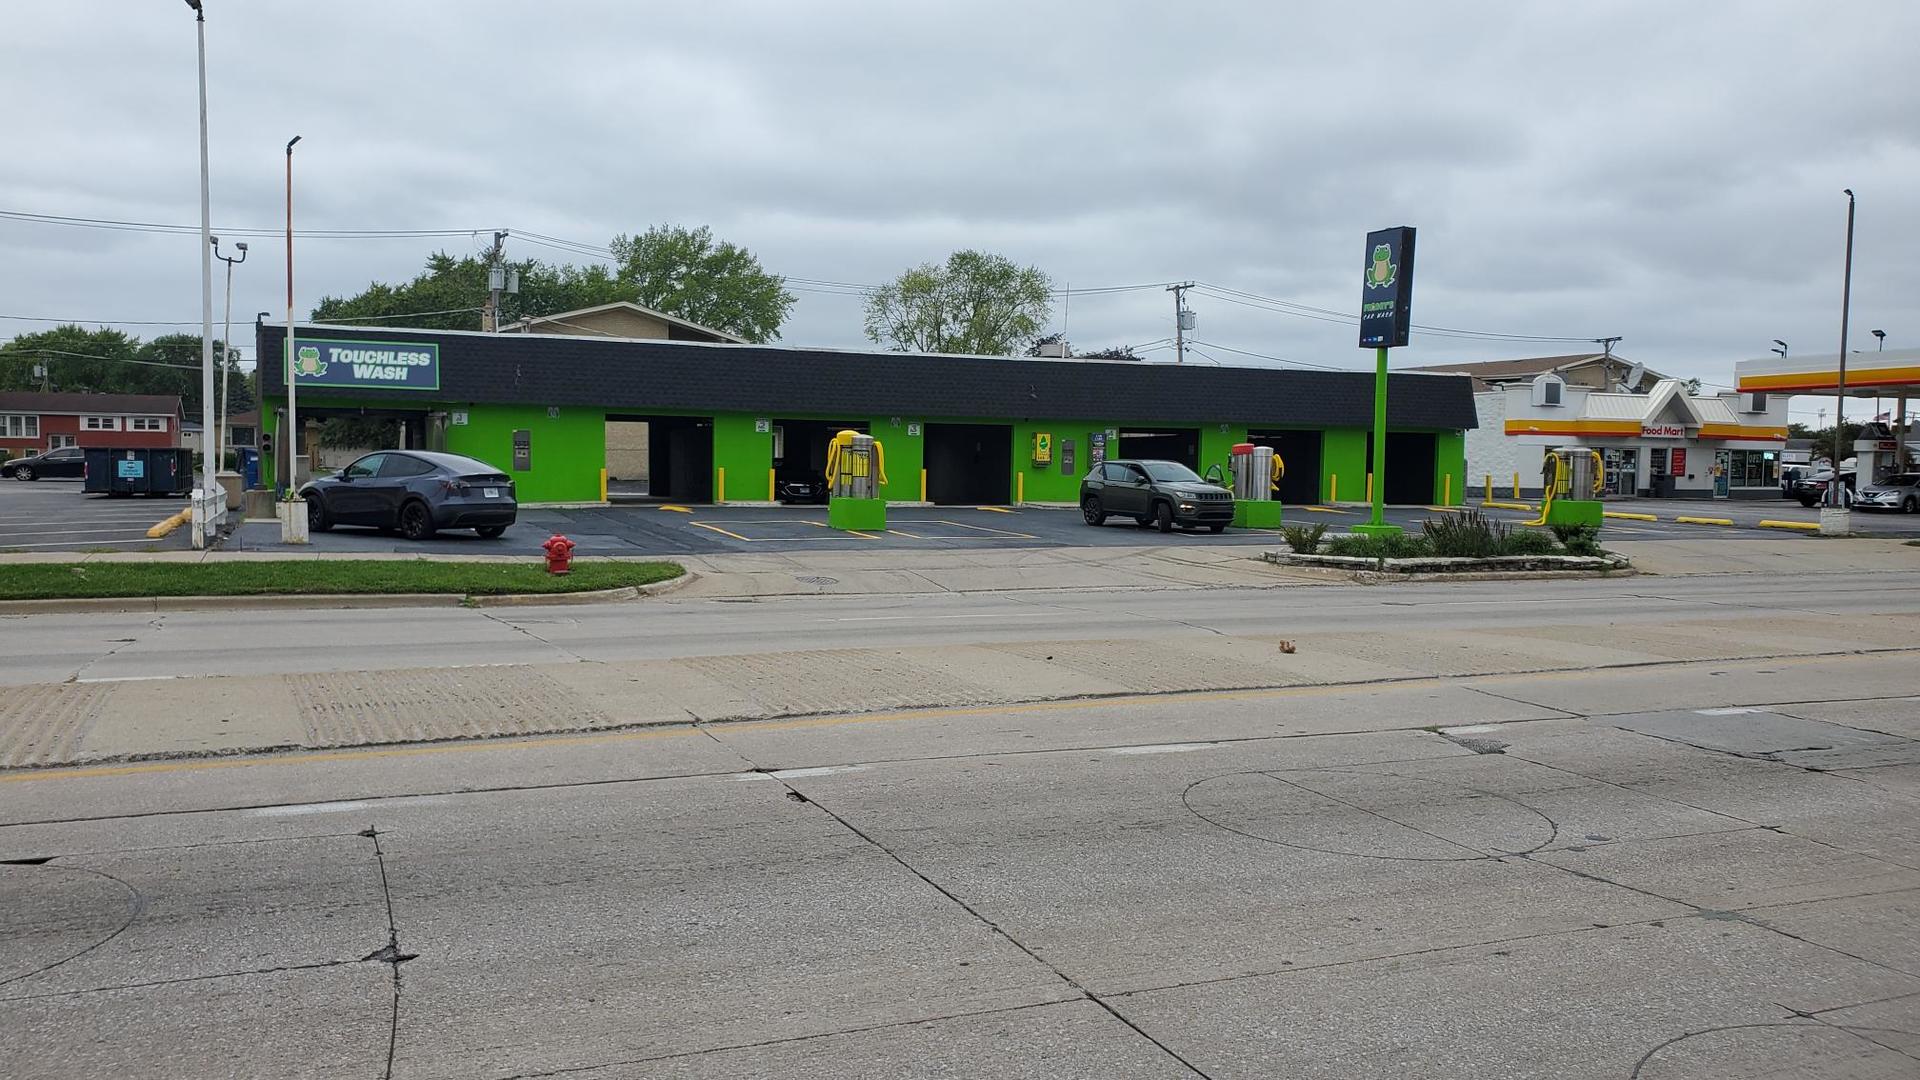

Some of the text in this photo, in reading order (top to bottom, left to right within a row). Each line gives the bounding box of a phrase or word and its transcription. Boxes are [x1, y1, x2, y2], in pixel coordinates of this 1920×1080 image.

[329, 348, 431, 366] TOUCHLESS
[352, 364, 408, 381] WASH
[1642, 424, 1684, 436] Food Mart
